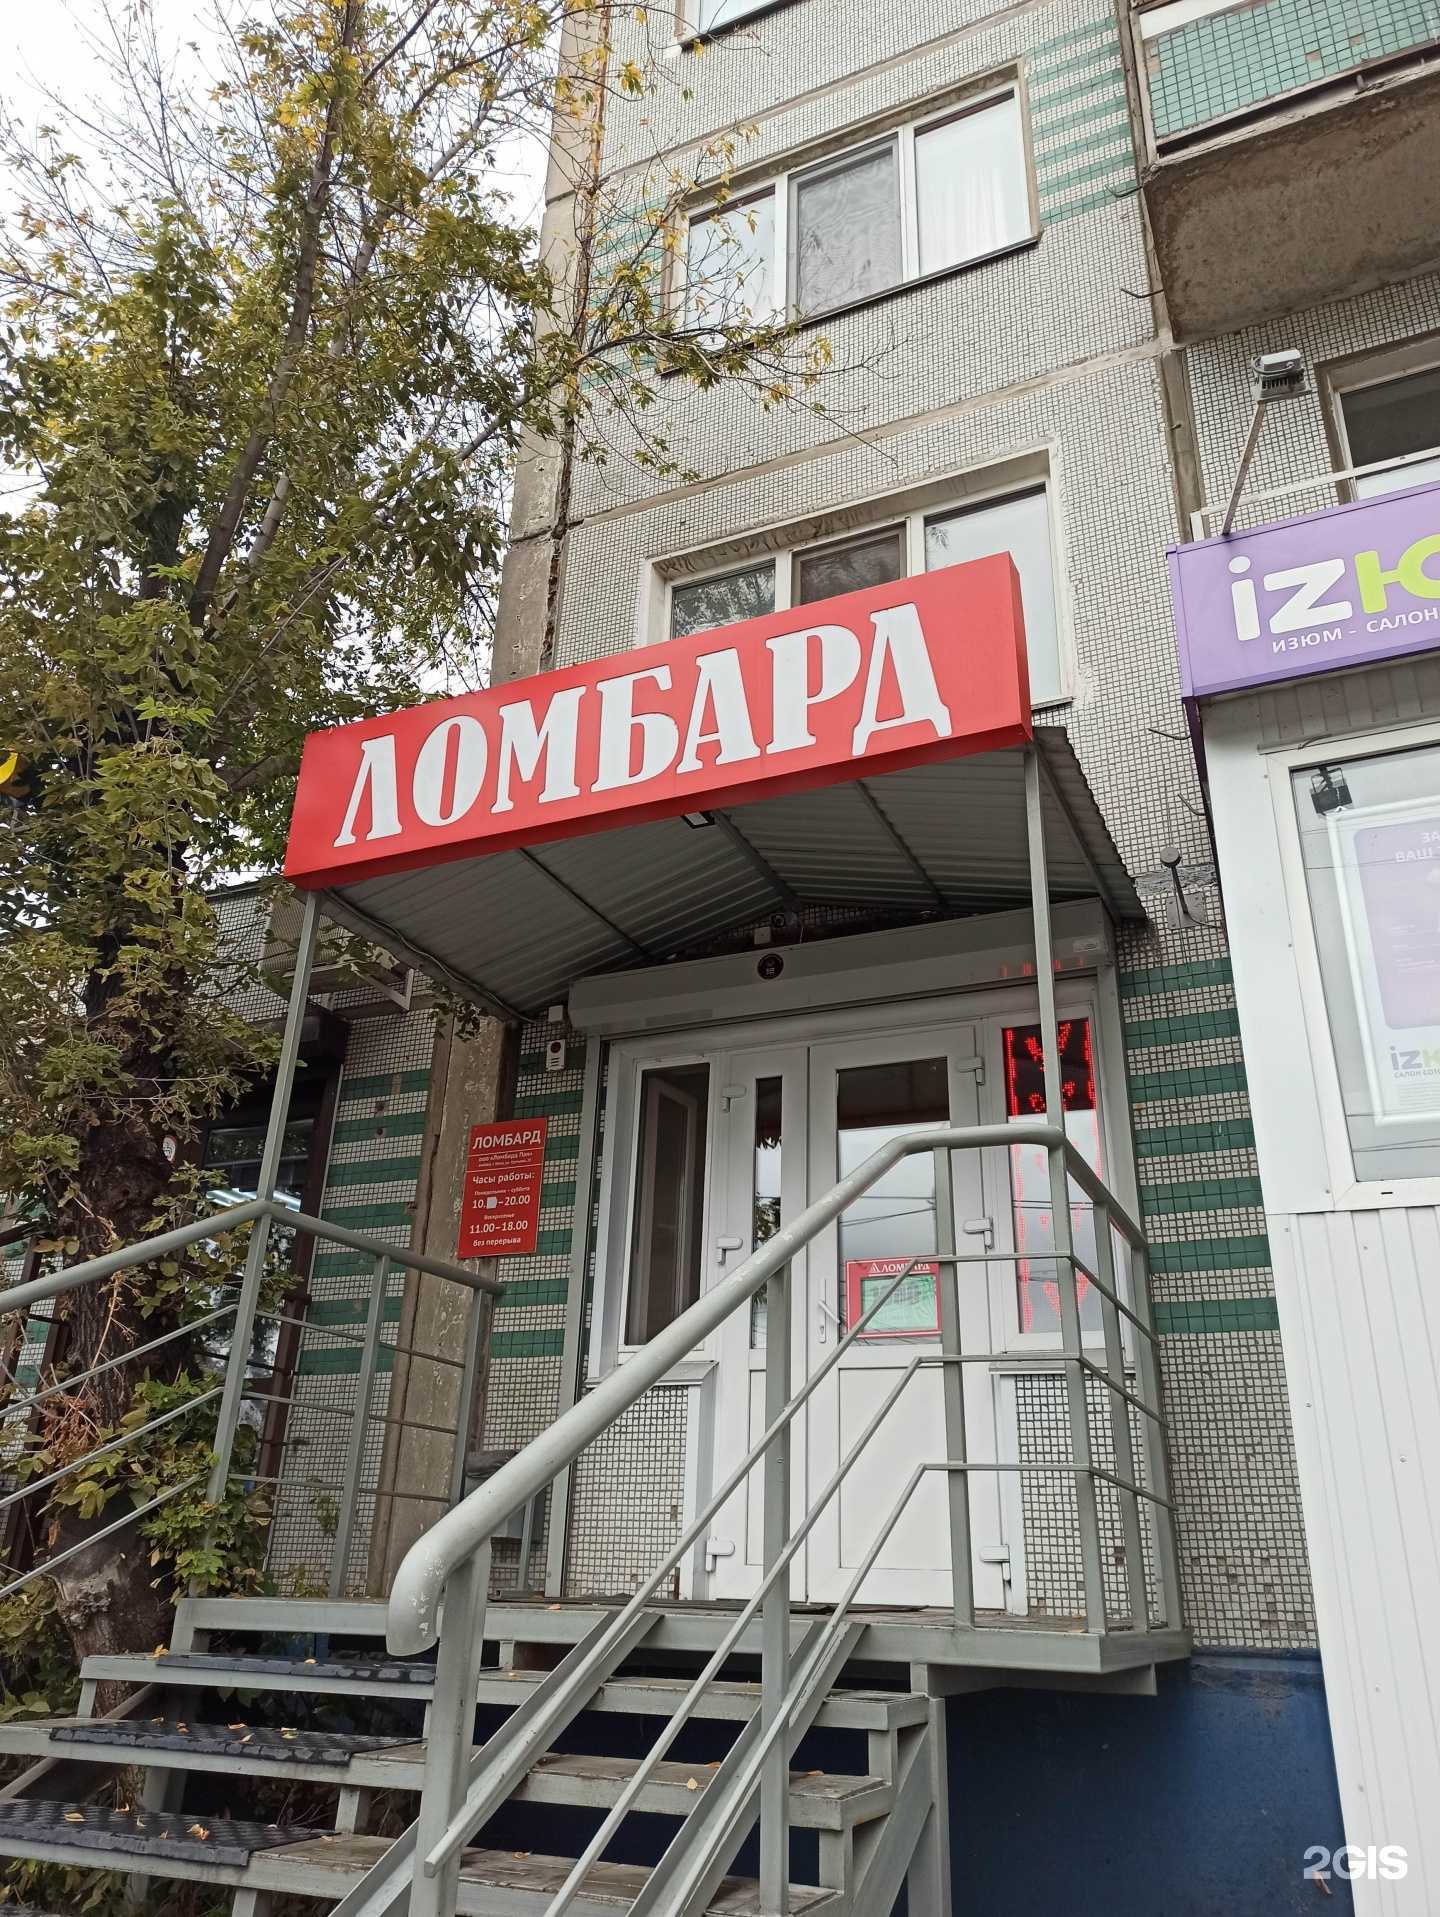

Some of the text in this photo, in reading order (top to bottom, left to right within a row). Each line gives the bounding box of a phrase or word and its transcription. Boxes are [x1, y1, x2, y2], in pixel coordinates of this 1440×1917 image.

[1272, 627, 1342, 653] ИЗЮМ
[1366, 607, 1439, 633] САЛОН
[333, 601, 952, 847] ЛОМБАРД
[472, 1130, 541, 1149] ЛОМБАРД
[472, 1171, 535, 1184] Часы работы:
[473, 1237, 521, 1247] без перерыва
[881, 1262, 930, 1273] ЛОМАРД
